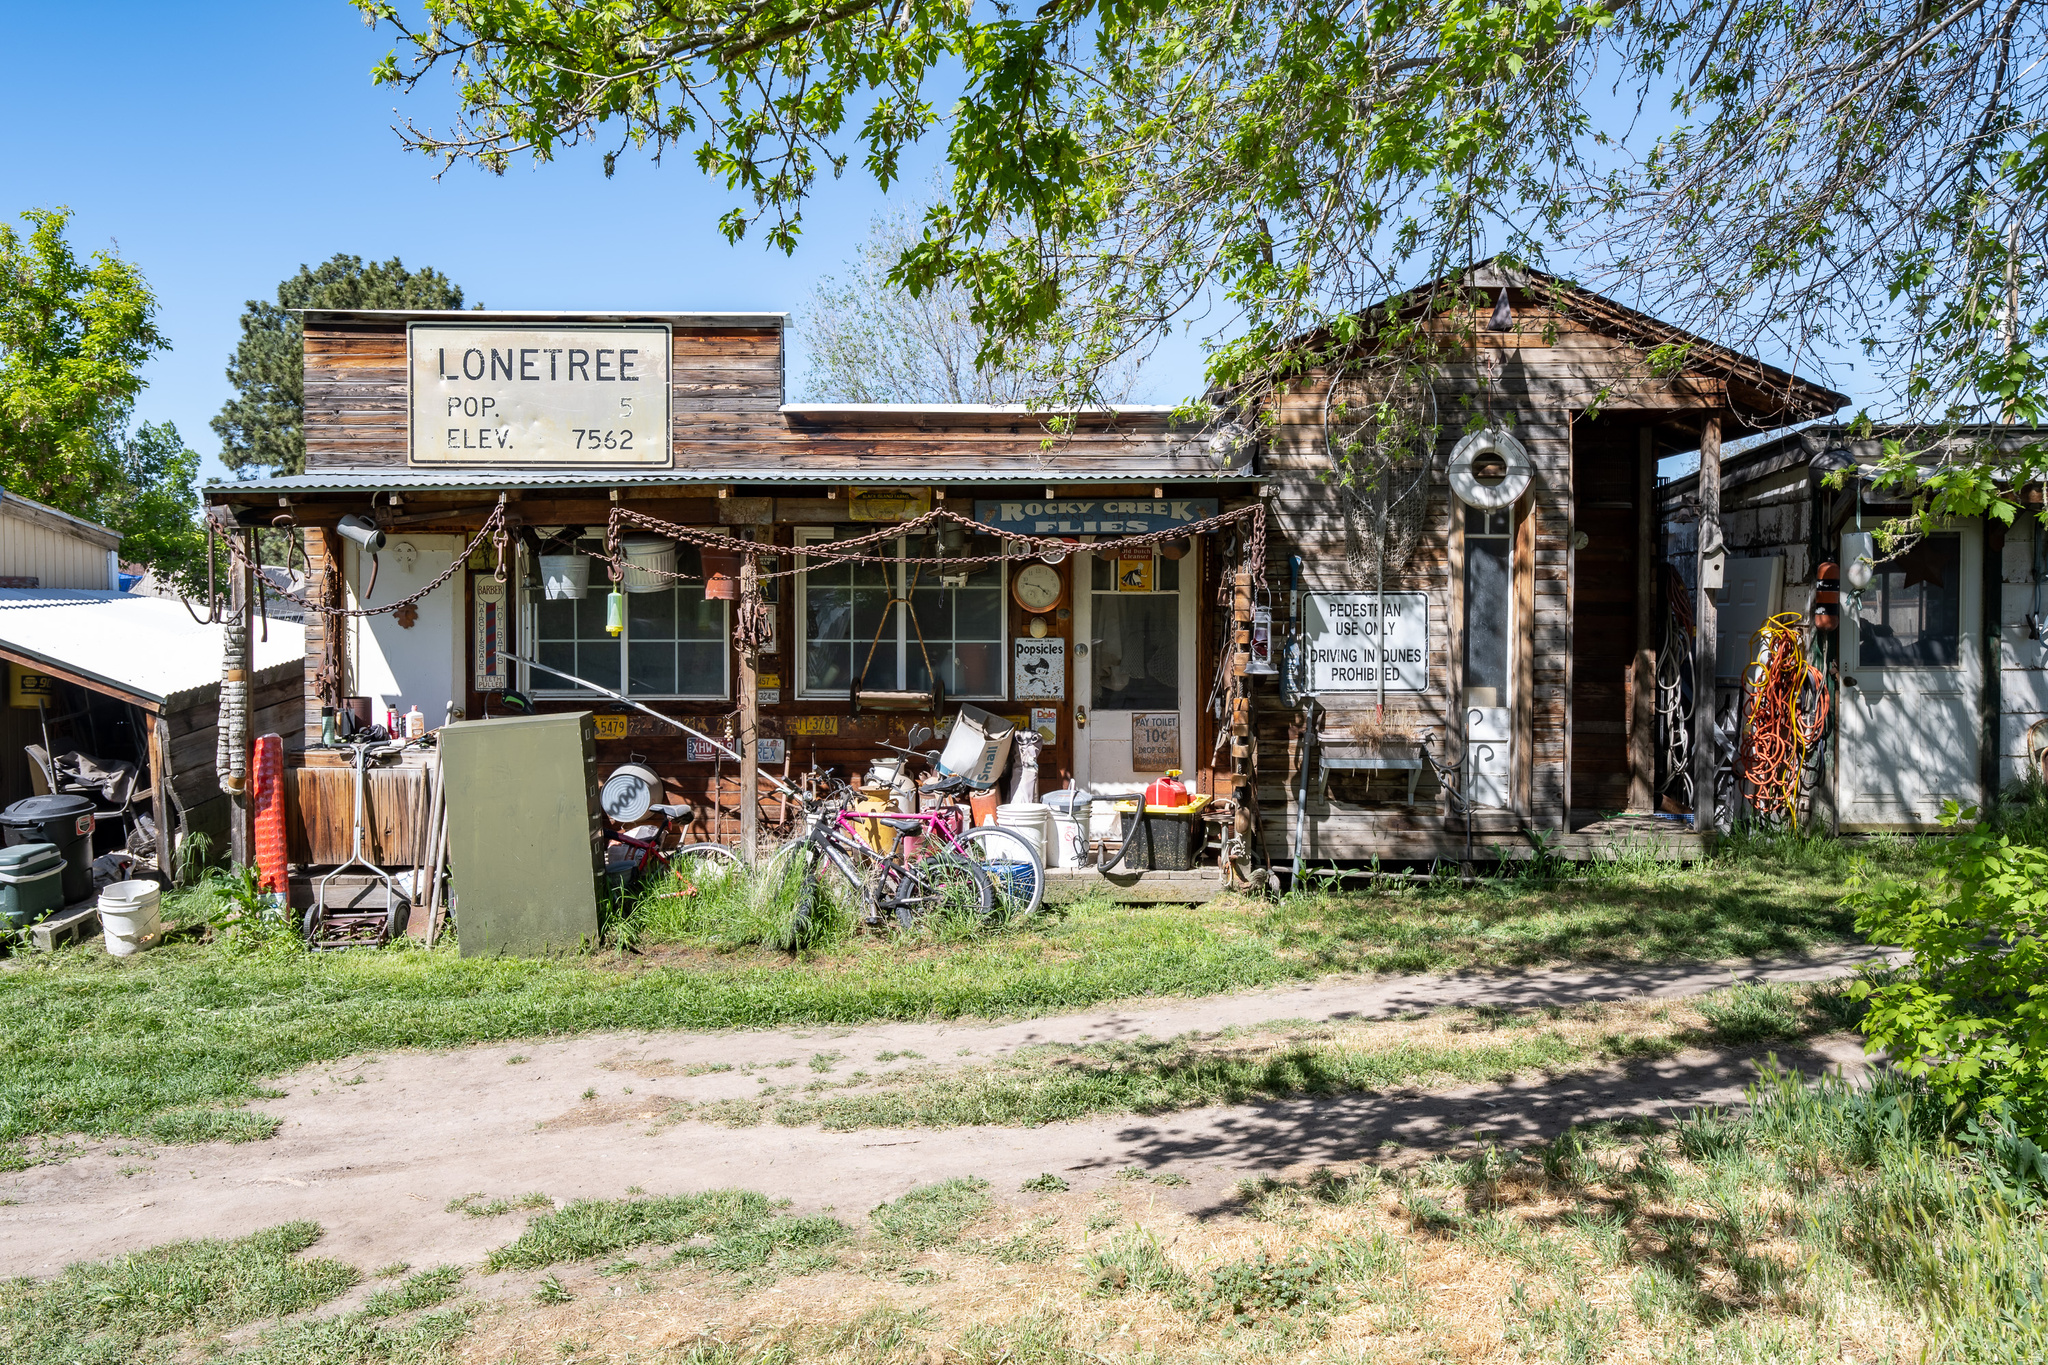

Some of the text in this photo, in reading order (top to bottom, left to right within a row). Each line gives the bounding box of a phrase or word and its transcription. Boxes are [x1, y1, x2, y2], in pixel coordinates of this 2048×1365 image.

[438, 348, 640, 382] LONETREE
[447, 396, 634, 418] POP. 5
[447, 428, 634, 450] ELEV. 7562
[1000, 501, 1195, 522] ROCKY CREEK
[1034, 520, 1149, 533] FLIES
[478, 585, 503, 595] BARBER
[1336, 622, 1358, 636] USE
[1016, 643, 1063, 658] Popsicles
[1310, 649, 1422, 663] DRIVING IN DUNES
[1331, 667, 1400, 681] PROHIBIED
[1036, 710, 1056, 719] Dole
[600, 721, 625, 734] 5479
[1135, 718, 1176, 727] PAY TOILET
[692, 742, 712, 753] XHW
[977, 745, 999, 782] Small
